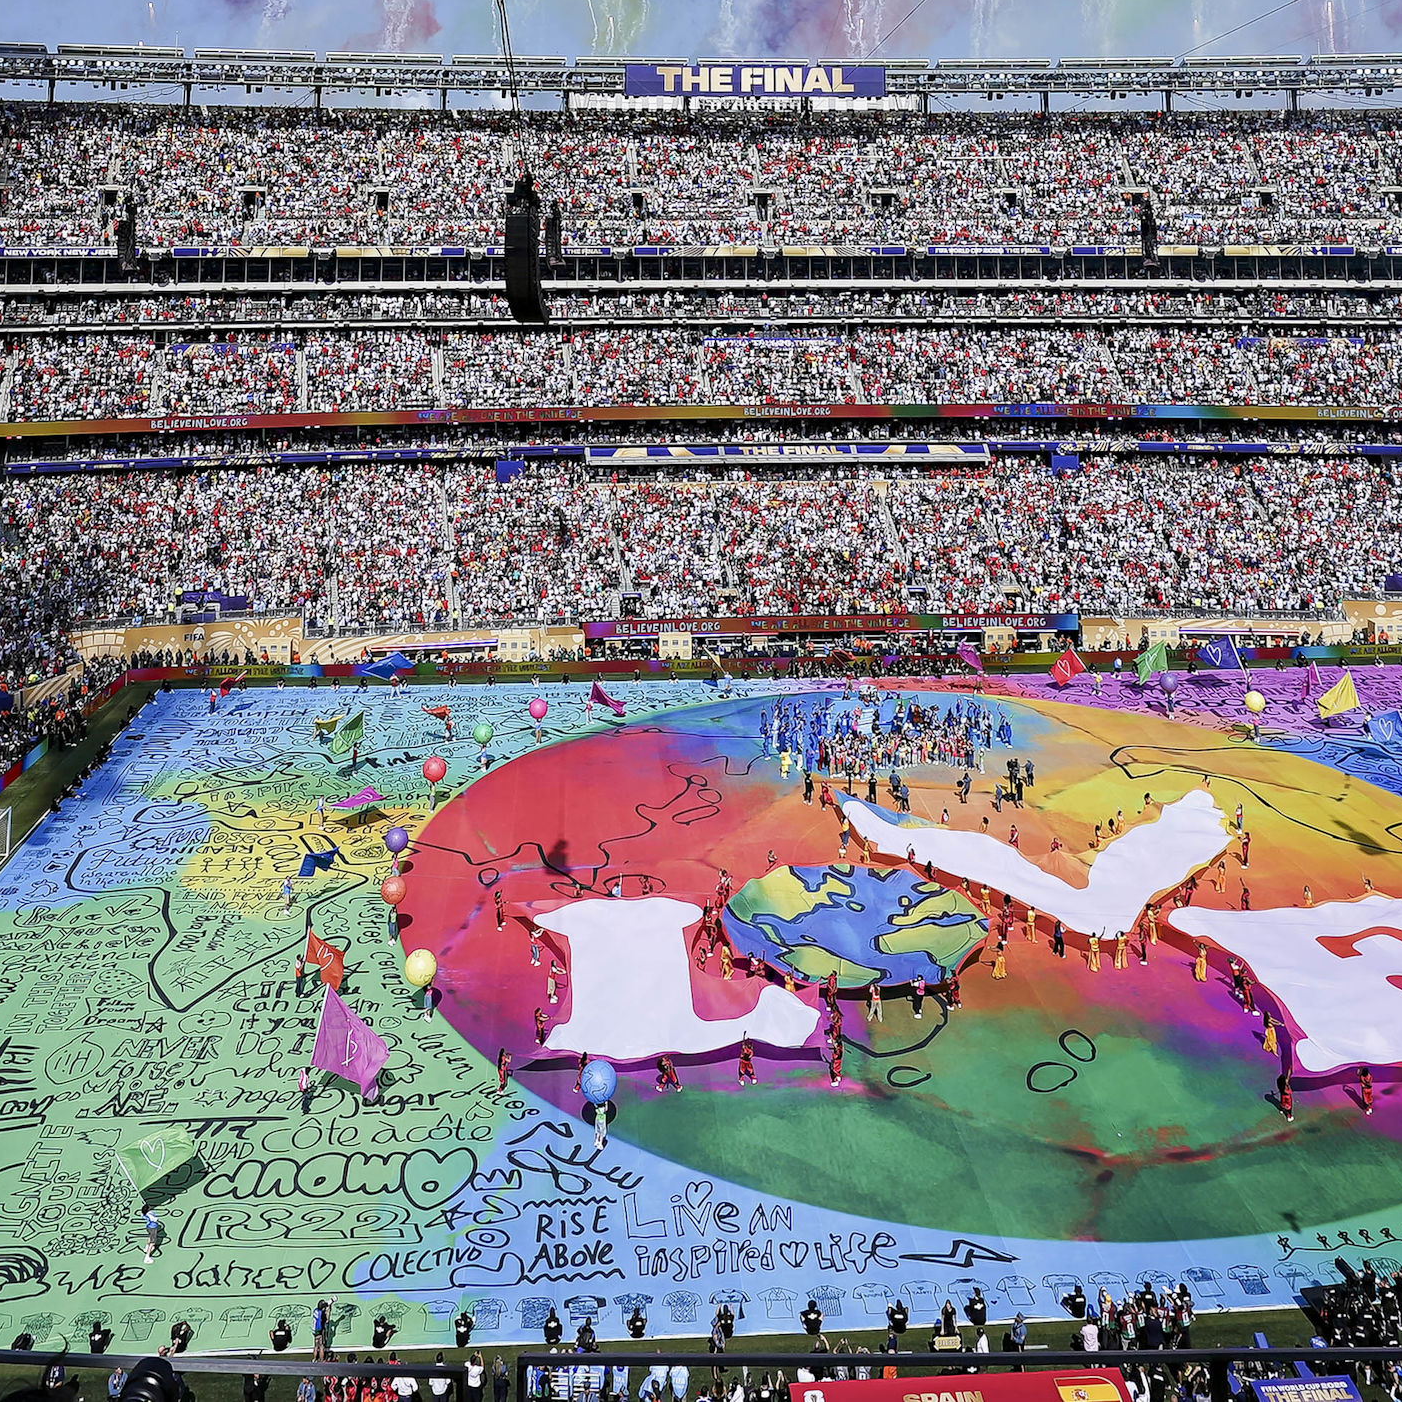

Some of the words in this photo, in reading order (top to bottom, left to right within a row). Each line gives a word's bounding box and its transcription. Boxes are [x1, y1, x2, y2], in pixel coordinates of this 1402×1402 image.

[657, 66, 735, 92] THE
[740, 66, 855, 92] FINAL
[743, 406, 832, 417] BELIEVEINLOVE.ORG
[149, 416, 249, 429] BELIEVEINLOVE.ORG
[739, 446, 781, 455] THE
[782, 446, 843, 455] FINAL
[615, 621, 721, 634] BELIEVEINLOVE.ORG
[943, 617, 1047, 629] BELIEVEINLOVE.ORG
[199, 1205, 418, 1242] PS22
[342, 1245, 486, 1288] COLECTIVO
[902, 1390, 986, 1402] SPAIN
[1264, 1391, 1298, 1402] THE
[1298, 1388, 1354, 1402] FINAL
